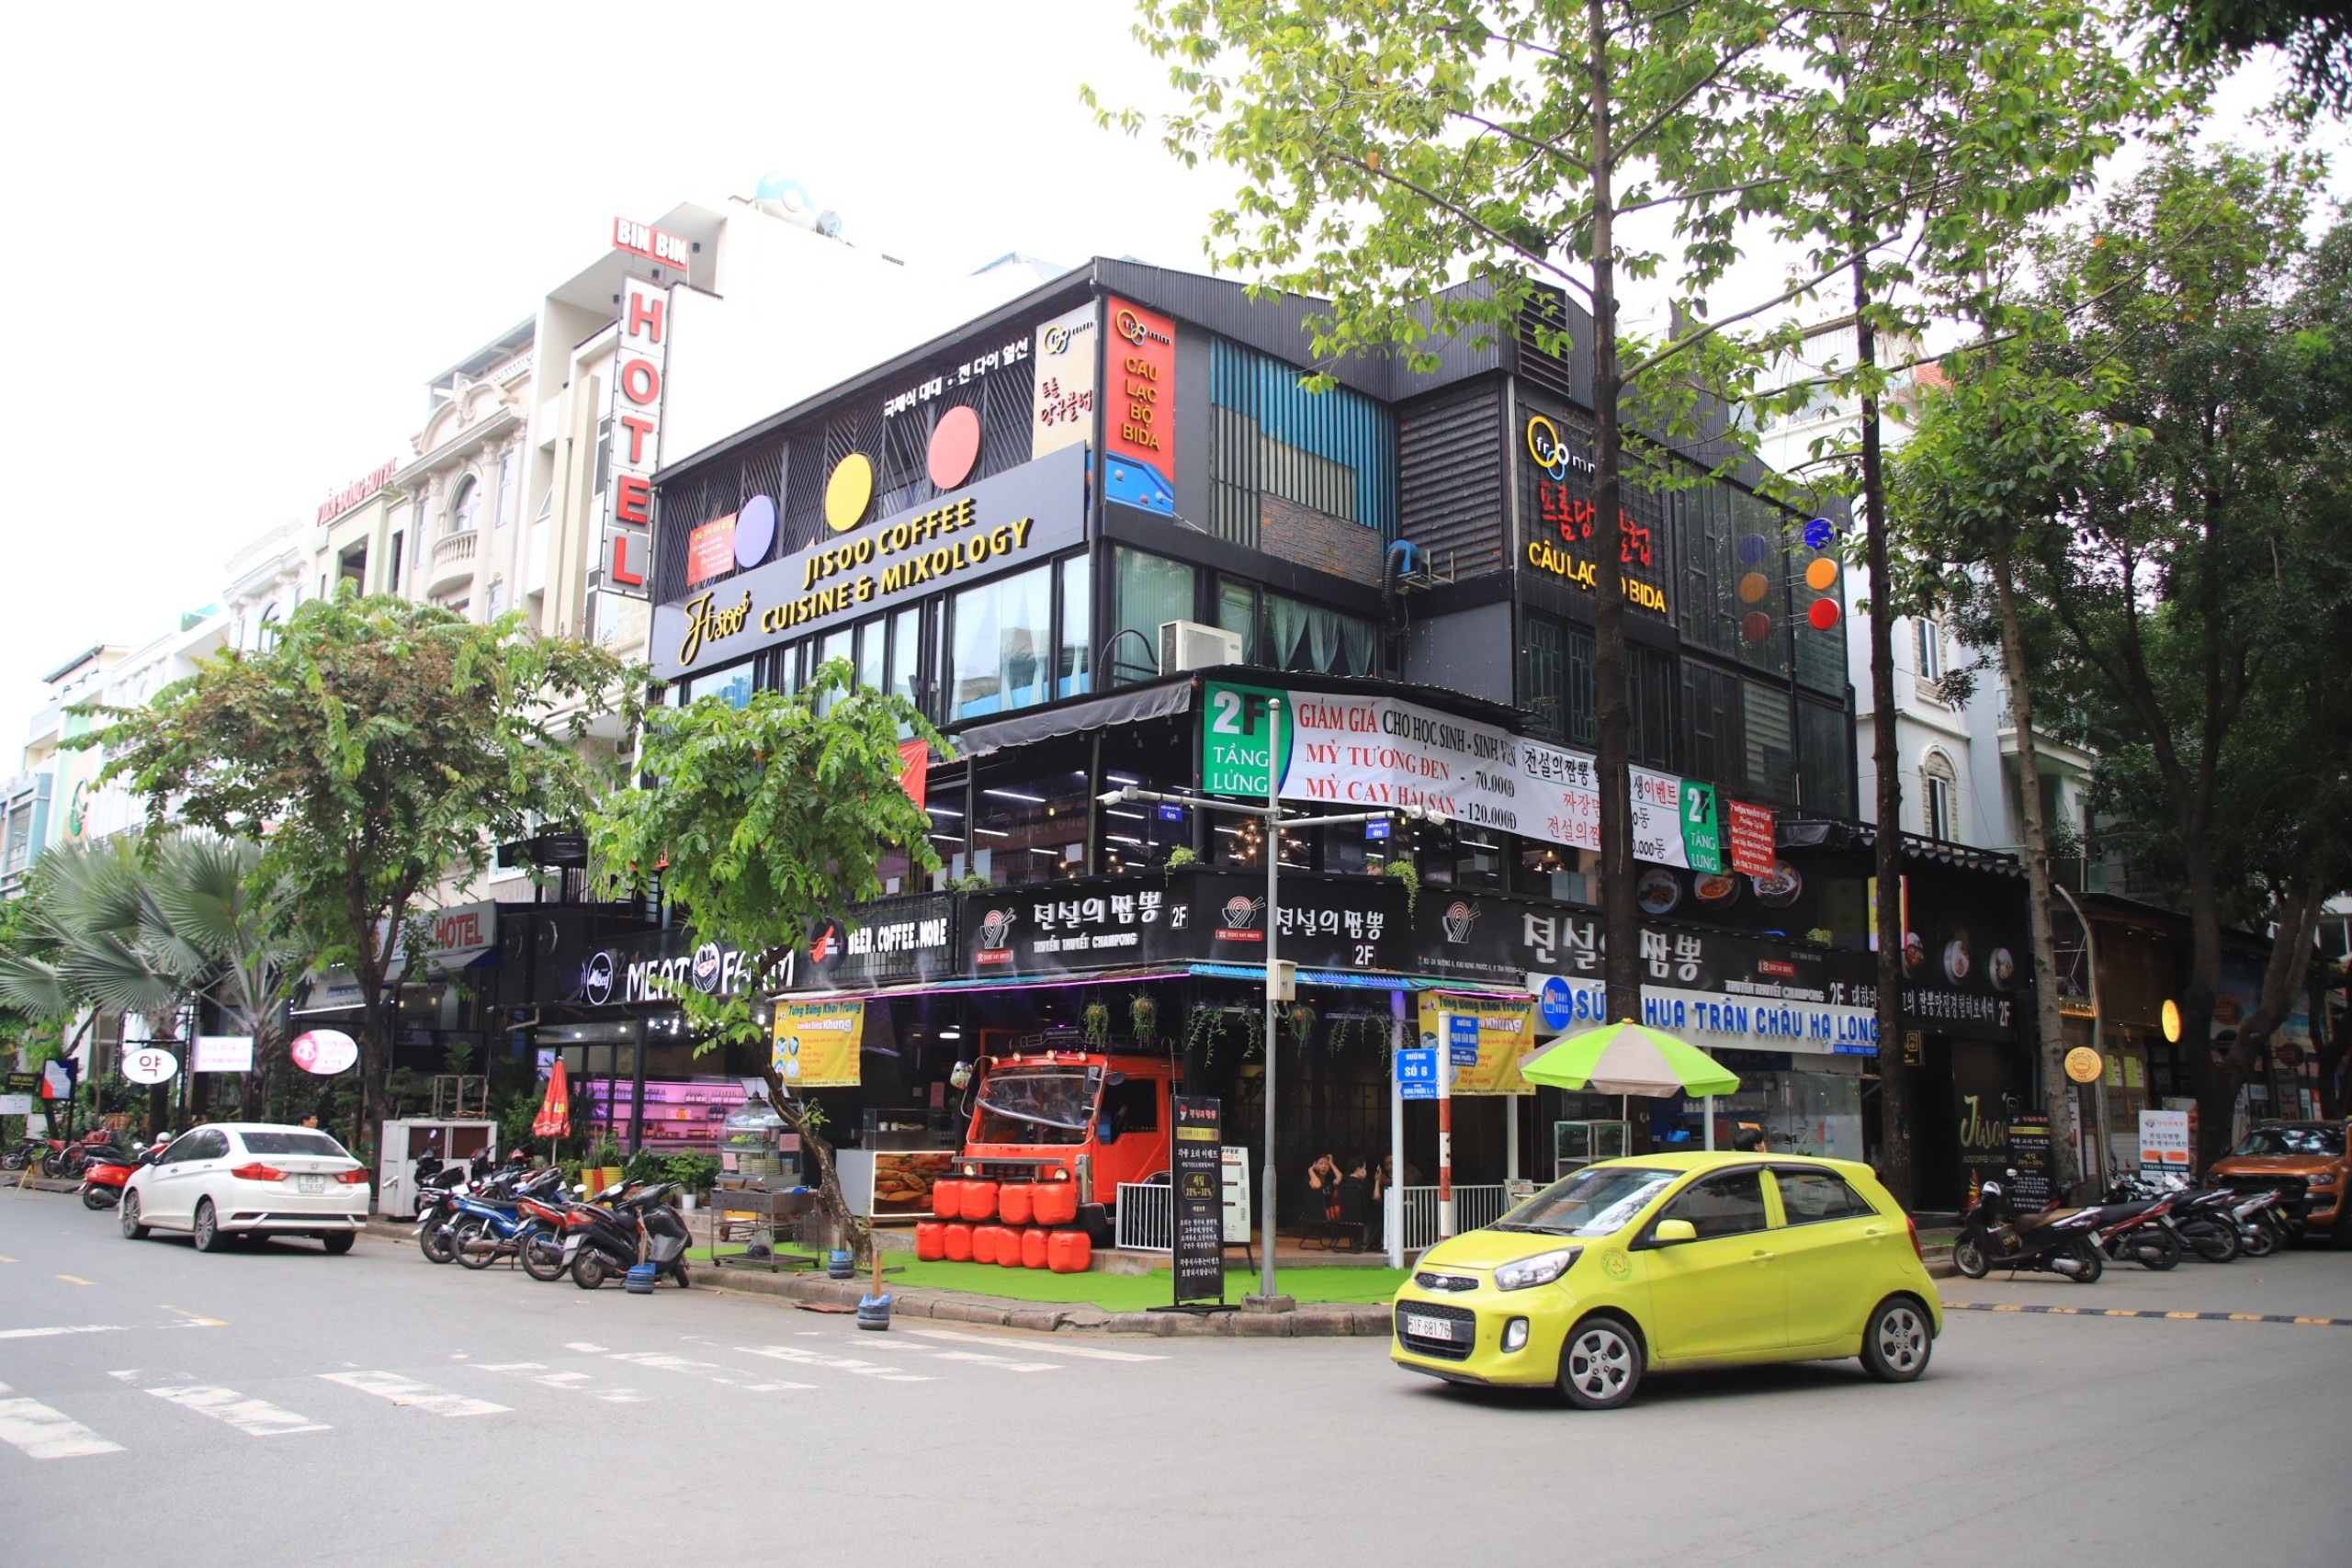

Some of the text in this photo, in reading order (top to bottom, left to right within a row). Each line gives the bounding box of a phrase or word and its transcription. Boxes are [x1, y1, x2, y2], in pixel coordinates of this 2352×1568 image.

[616, 220, 689, 265] BIN BIN
[919, 376, 943, 401] 대대
[974, 351, 999, 375] 다이
[1125, 355, 1159, 382] CÂU
[1125, 378, 1158, 404] LẠC
[1129, 401, 1154, 428] BỘ
[613, 291, 663, 586] HOTEL
[1122, 422, 1160, 451] BIDA
[802, 536, 870, 592] JISOO
[876, 496, 977, 556] COFFEE
[759, 516, 1035, 636] CUISINE & MIXOLOGY
[1528, 539, 1565, 575] CÂU
[1629, 577, 1667, 614] BIDA
[1213, 690, 1267, 736] 2F
[1297, 696, 1344, 731] GIẢM
[1348, 701, 1379, 733] GIÁ
[1382, 709, 1410, 739] CHO
[1413, 716, 1438, 750] HỌC
[1439, 721, 1466, 753] SINH
[1473, 732, 1498, 761] SINH
[1213, 742, 1270, 767] TẦNG
[1306, 739, 1340, 764] MỲ
[1347, 744, 1417, 774] TƯƠNG
[1419, 757, 1450, 781] ĐEN
[1213, 771, 1270, 794] LỬNG
[1306, 773, 1340, 799] MỲ
[1347, 781, 1394, 804] CAY
[1687, 786, 1711, 825] 2F
[1110, 891, 1163, 924] 짬뽕
[1171, 906, 1187, 928] 2F
[435, 912, 483, 950] HOTEL
[1344, 908, 1385, 941] 짬뽕
[1034, 931, 1139, 953] TRUYỀN THUYẾT CHAMPONG
[1354, 943, 1374, 965] 2F
[1522, 911, 1703, 982] 전설 짬뽕
[627, 956, 691, 1003] MEAT
[1781, 987, 1825, 1002] CHAMPONG
[1829, 981, 1845, 1006] 2F
[1572, 983, 1879, 1045] SỮ HUA TRÂN CHÂU HẠ LONG
[1998, 1000, 2010, 1027] 2F
[139, 1055, 162, 1077] 약
[1404, 1062, 1429, 1077] SỐ 6
[1406, 1052, 1427, 1061] ĐƯỜNG
[1202, 1148, 1219, 1159] 이벤트
[1193, 1175, 1204, 1187] 세일
